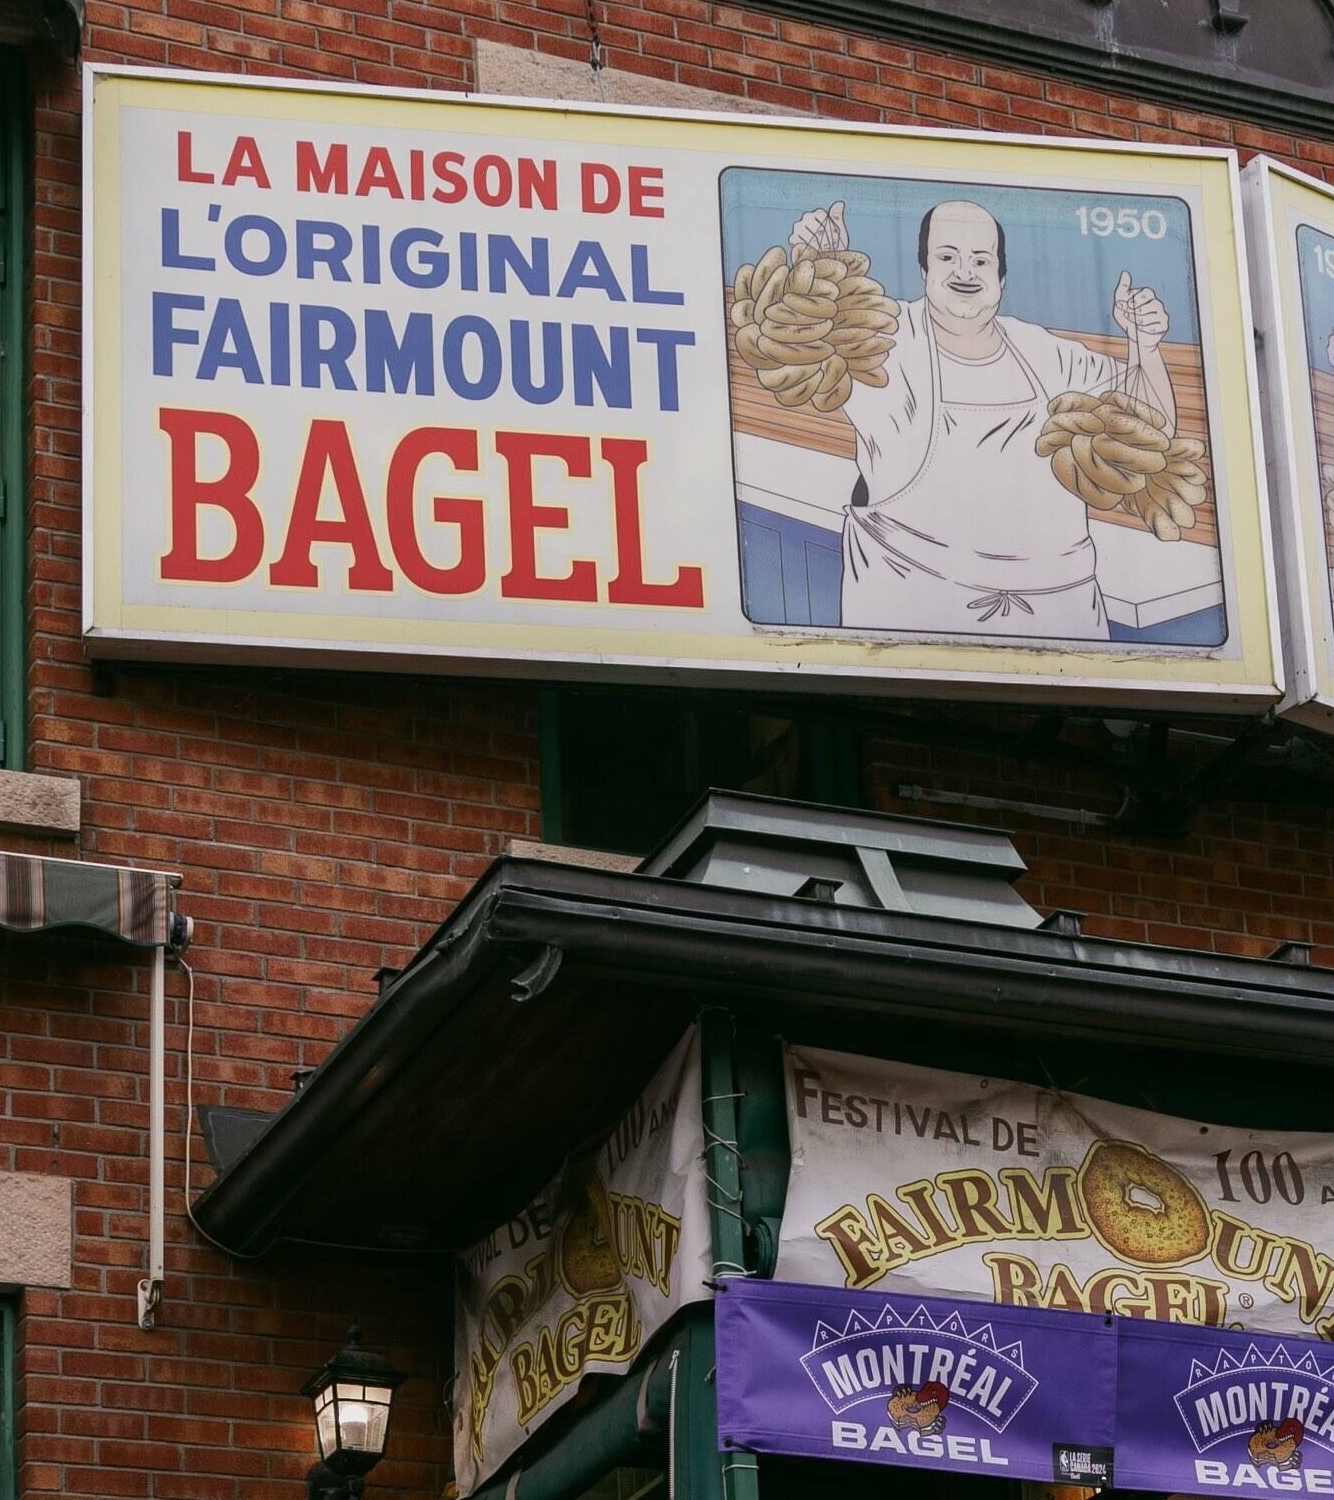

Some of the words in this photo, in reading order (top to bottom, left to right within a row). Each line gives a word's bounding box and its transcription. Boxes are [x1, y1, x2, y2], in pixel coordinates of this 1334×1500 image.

[177, 130, 271, 189] LA
[295, 140, 558, 211] MAISON
[580, 162, 665, 218] DE
[161, 203, 684, 306] L'ORIGINAL
[1076, 206, 1166, 239] 1950
[152, 291, 695, 412] FAIRMOUNT
[158, 406, 704, 608] BAGEL
[794, 1069, 980, 1146] FESTIVAL
[992, 1117, 1040, 1157] DE
[1214, 1150, 1304, 1206] 100
[508, 1203, 552, 1249] DE
[510, 1290, 642, 1427] BAGEL
[820, 1315, 1018, 1359] RAPTORS
[821, 1344, 1013, 1417] MONTRÉAL
[832, 1420, 1009, 1465] BAGEL
